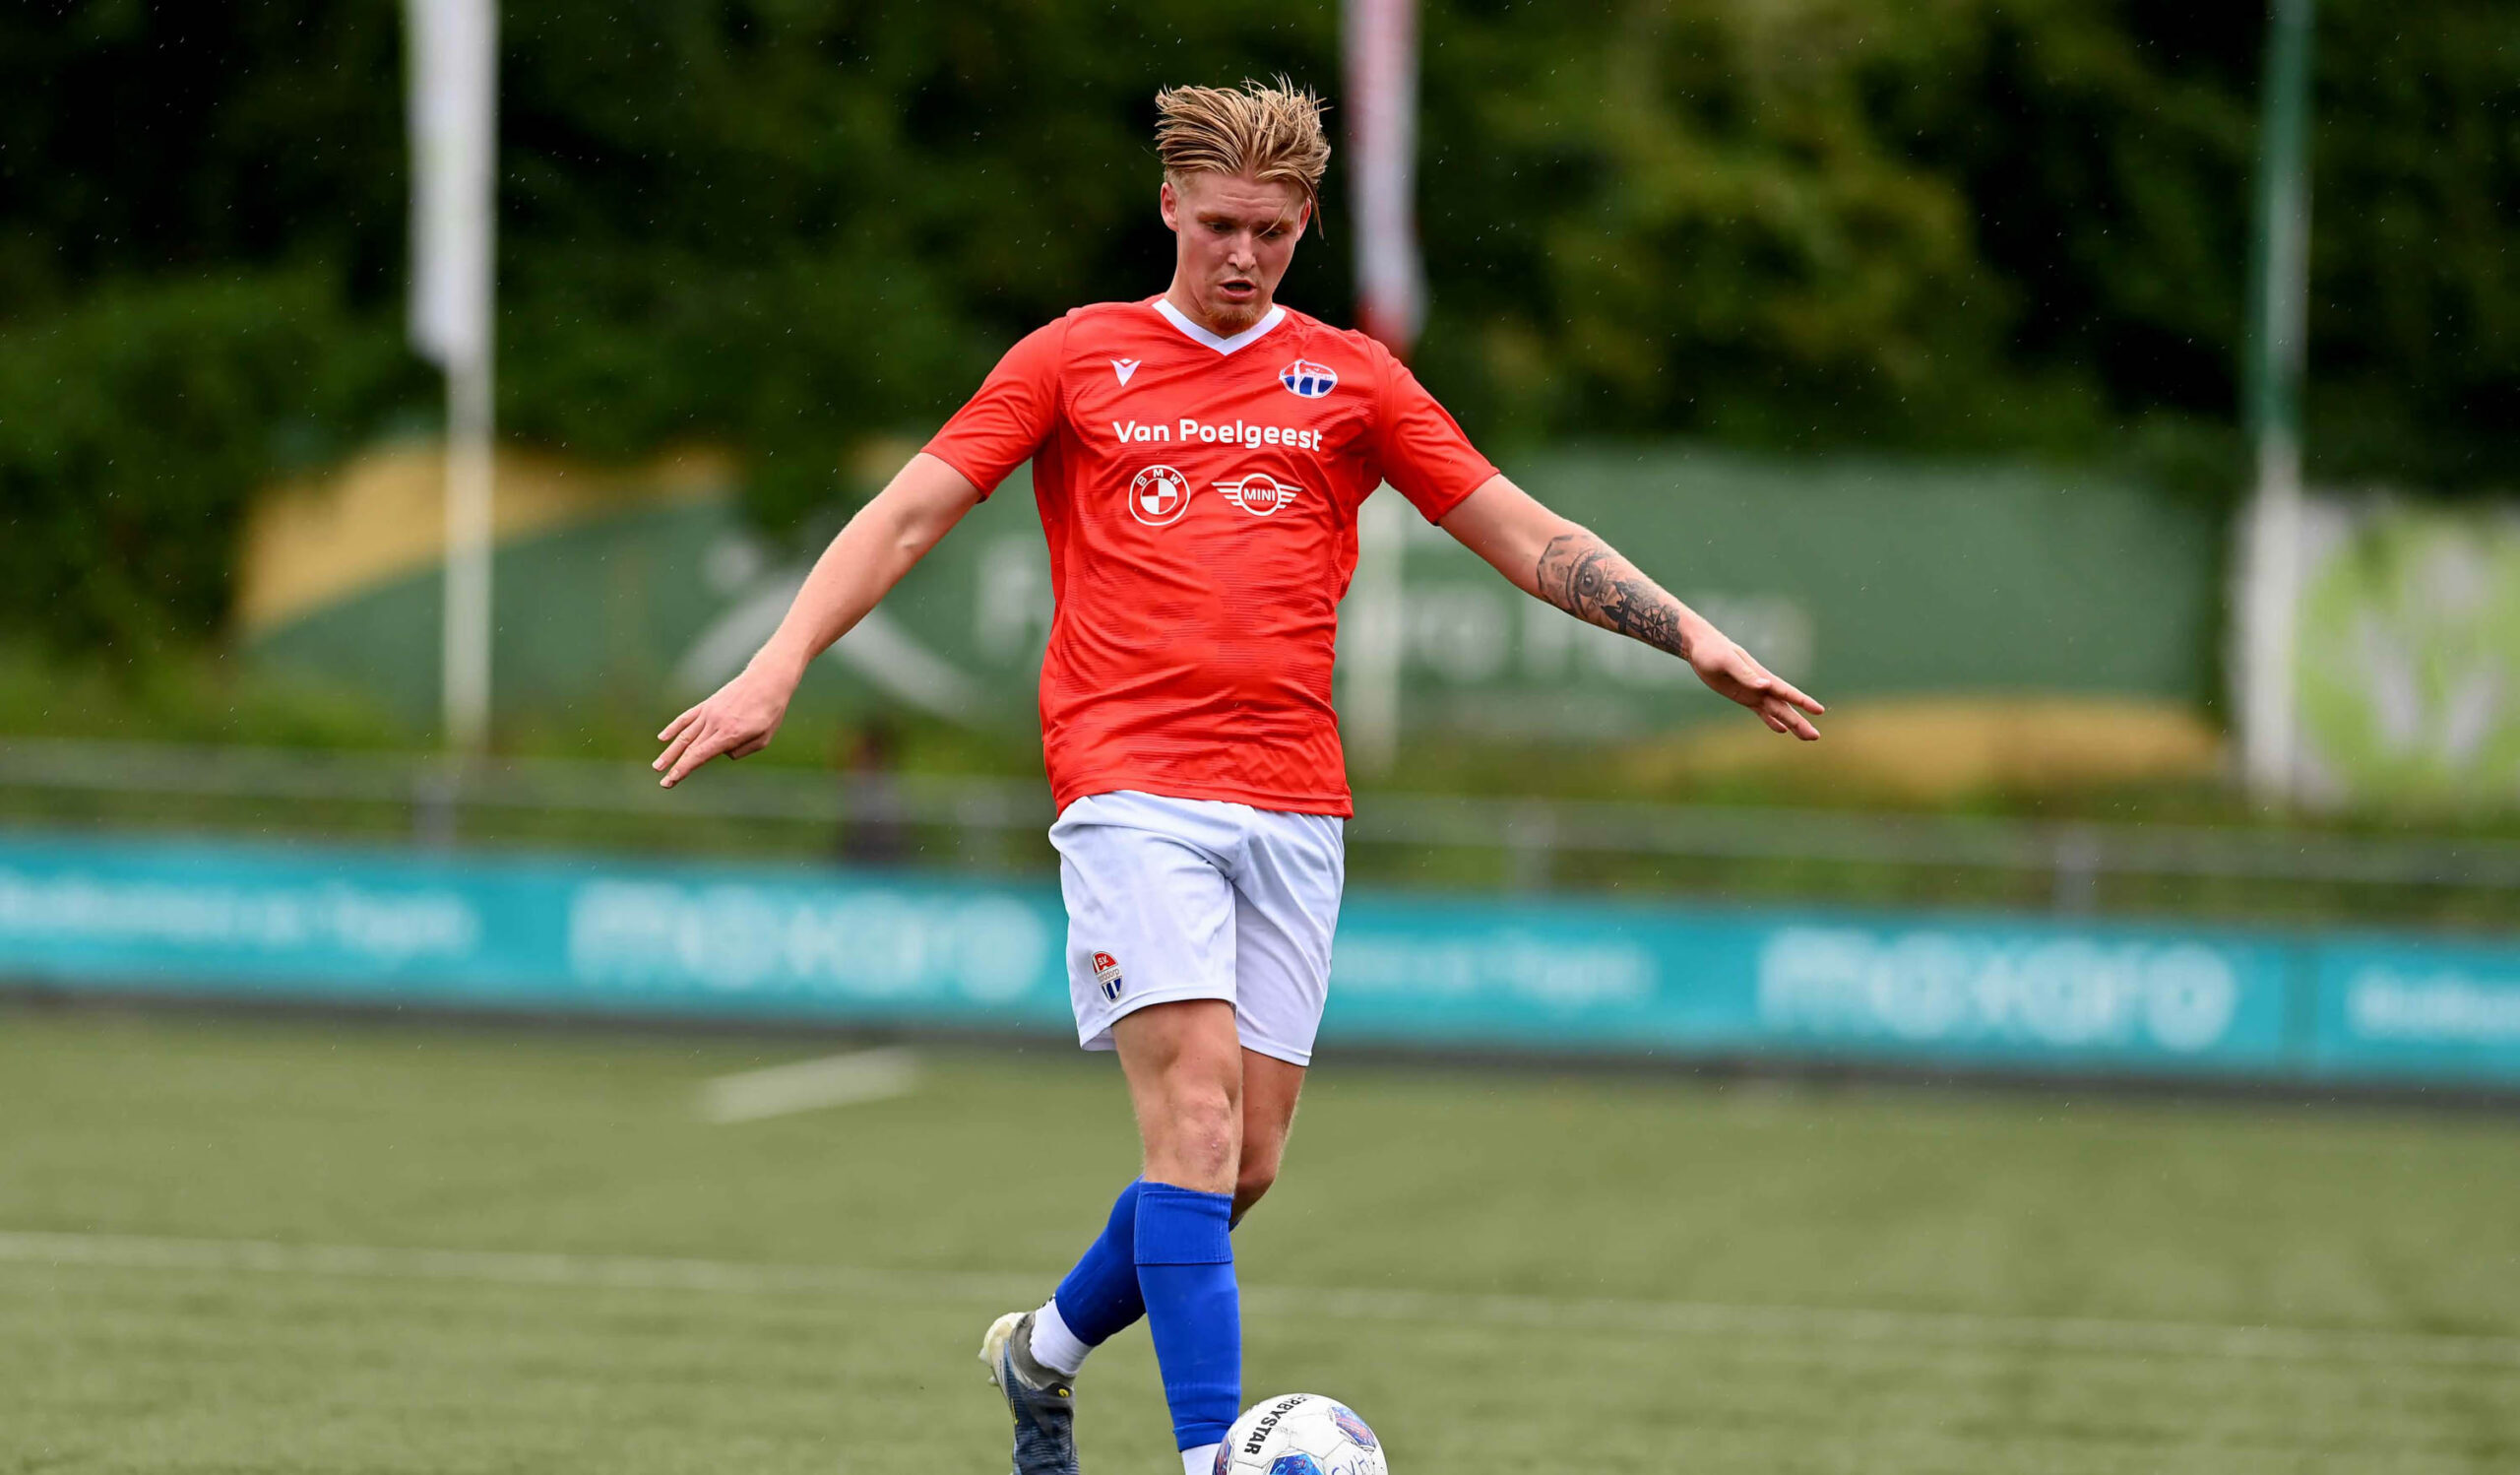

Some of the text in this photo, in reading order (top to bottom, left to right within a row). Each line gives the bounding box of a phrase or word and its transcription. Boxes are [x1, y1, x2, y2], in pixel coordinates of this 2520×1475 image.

[1112, 418, 1323, 452] Van Poelgeest
[1137, 468, 1182, 486] BMW
[1243, 487, 1277, 502] MINI
